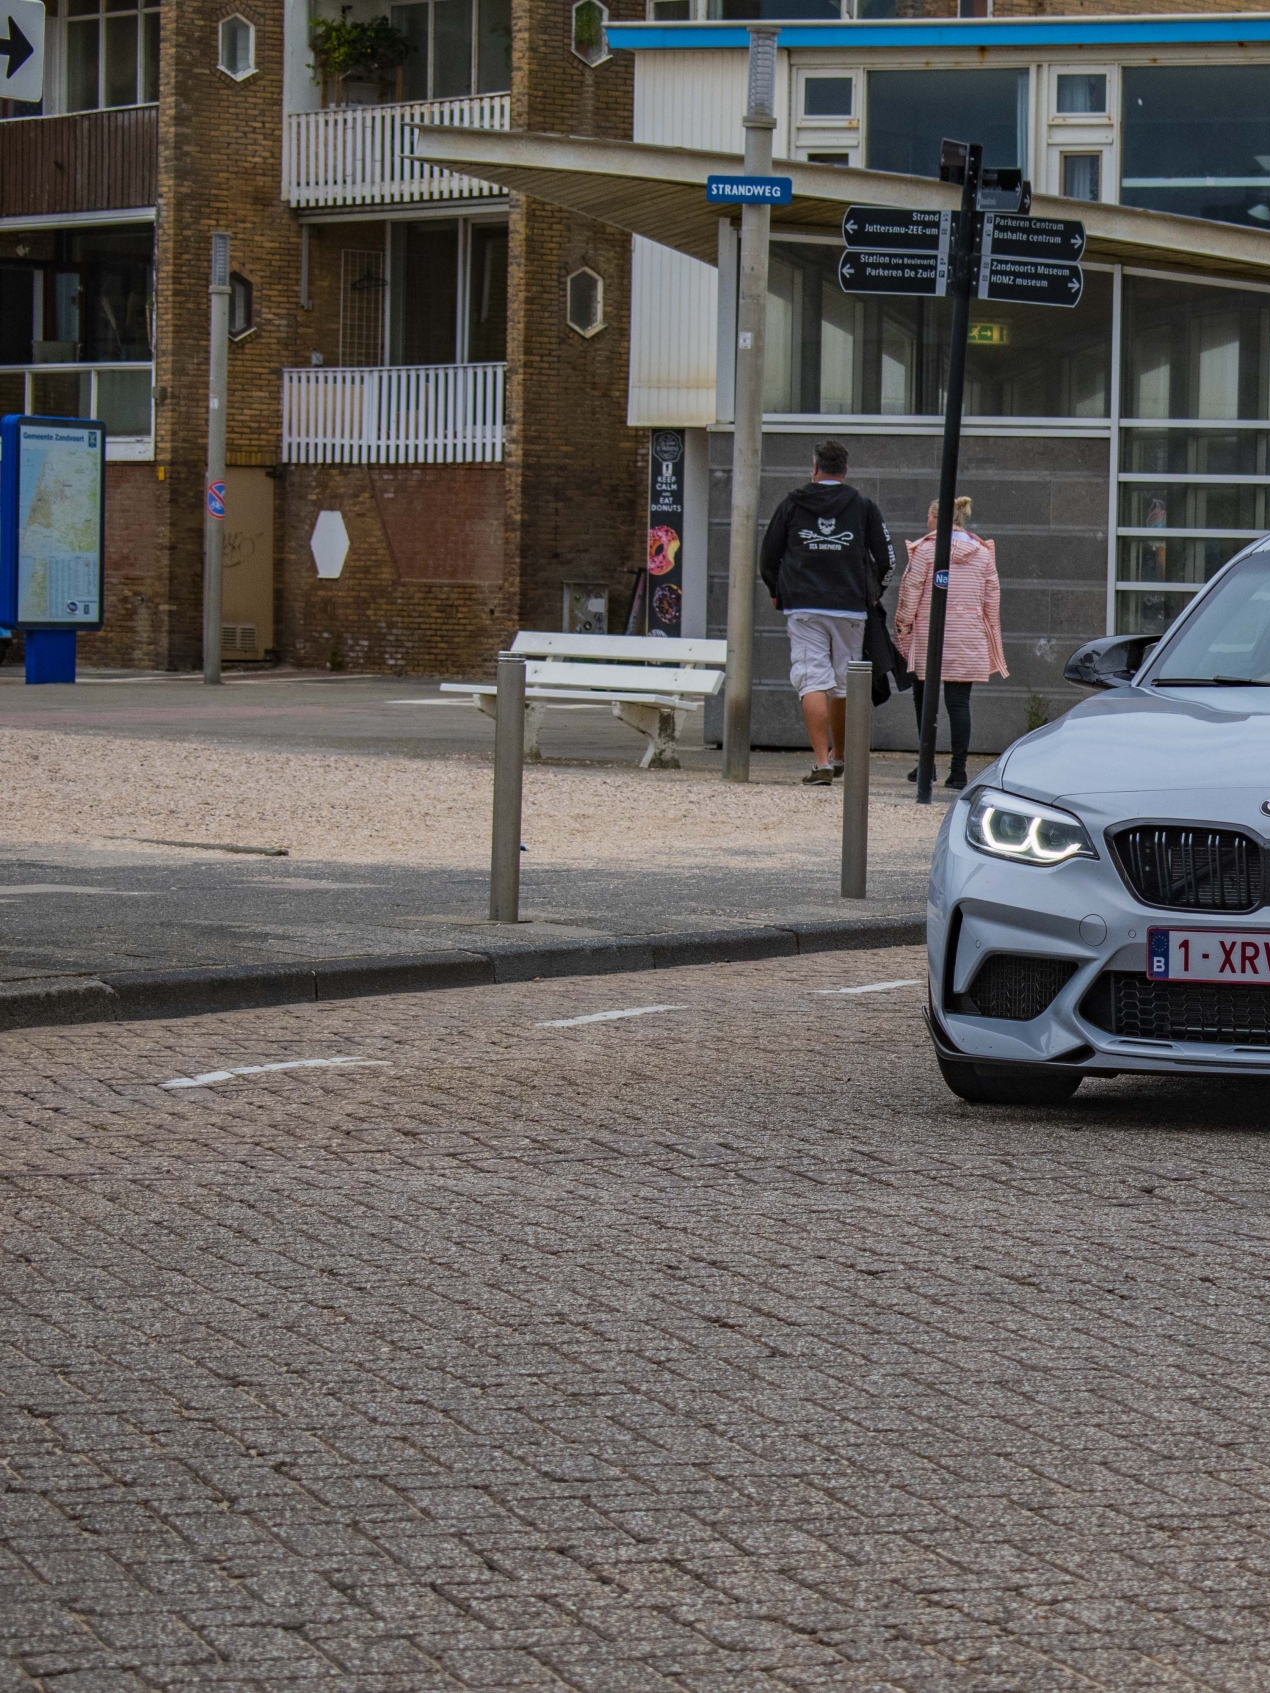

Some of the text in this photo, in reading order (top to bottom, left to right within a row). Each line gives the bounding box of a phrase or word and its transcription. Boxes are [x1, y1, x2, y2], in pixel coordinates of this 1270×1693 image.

[711, 184, 781, 197] STRANDWEG
[912, 212, 939, 222] Strand
[864, 223, 938, 235] Juttersmu-ZEE-um
[995, 217, 1064, 231] Parkeren Centrum
[993, 230, 1062, 244] Bushalte centrum
[860, 254, 890, 263] Station
[866, 267, 936, 278] Parkeren De Zuid
[991, 261, 1070, 276] Zandvoorts Museum
[990, 275, 1048, 288] HDMZ museum
[23, 431, 85, 442] Gemeente Zandvoort
[651, 504, 682, 512] DONUTS
[1153, 957, 1165, 972] B
